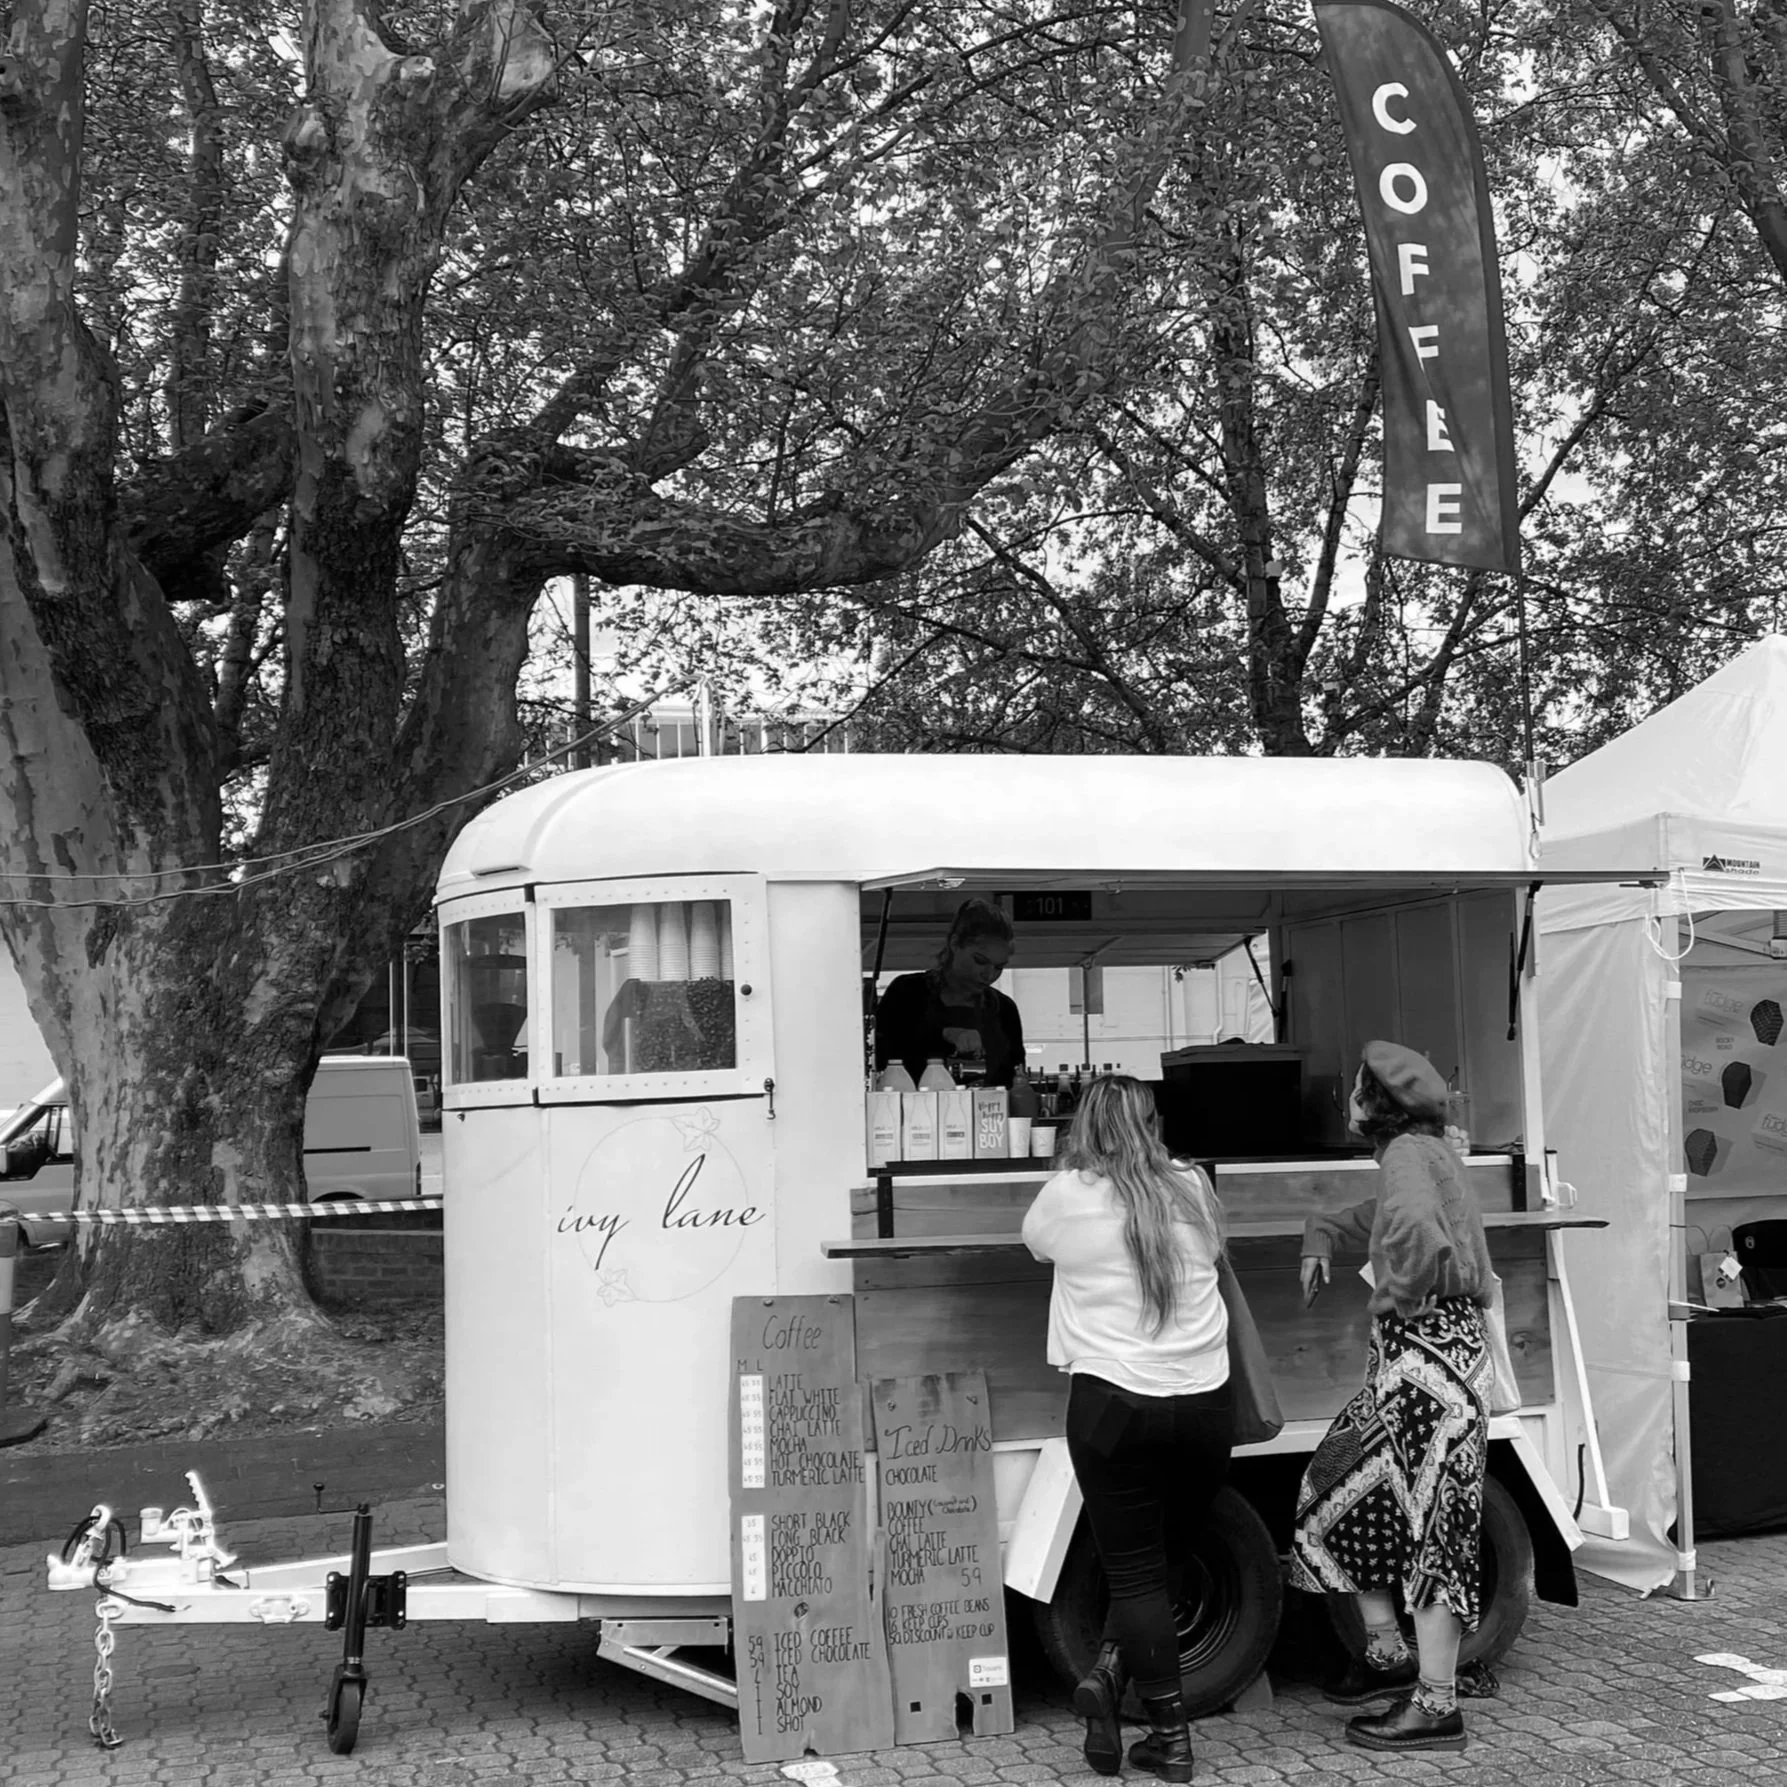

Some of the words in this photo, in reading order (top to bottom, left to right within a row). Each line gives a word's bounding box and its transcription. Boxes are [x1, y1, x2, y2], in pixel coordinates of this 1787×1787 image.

[1373, 82, 1463, 534] COFFEE
[1727, 859, 1760, 869] MOUNTAIN
[979, 1133, 1004, 1149] BOY
[557, 1205, 630, 1271] ivy
[661, 1153, 767, 1229] lane
[762, 1314, 822, 1350] Coffee
[737, 1359, 747, 1372] M
[757, 1359, 764, 1372] L
[768, 1373, 802, 1391] LATTE
[769, 1389, 795, 1406] FLAT
[803, 1387, 840, 1405] WHITE
[769, 1404, 837, 1421] CAPPUCCINO
[769, 1420, 798, 1438] CHAI
[808, 1419, 840, 1437] LATTE
[769, 1437, 807, 1455] MOCHA
[884, 1424, 934, 1460] Iced
[770, 1453, 791, 1470] HOT
[799, 1451, 860, 1469] CHOCOLATE
[771, 1469, 830, 1487] TURMERIC
[832, 1466, 865, 1485] LATTE
[885, 1465, 938, 1486] CHOCOLATE
[771, 1512, 807, 1531] SHORT
[816, 1511, 850, 1529] BLACK
[888, 1517, 925, 1536] COFFEE
[771, 1529, 800, 1547] LONG
[810, 1527, 846, 1546] BLACK
[889, 1535, 911, 1554] CHAI
[918, 1530, 947, 1551] LATTE
[771, 1545, 814, 1563] DOPPIO
[892, 1549, 944, 1569] TURMERIC
[948, 1545, 979, 1565] LATTE
[771, 1561, 823, 1581] PICCOLO
[891, 1568, 925, 1587] MOCHA
[771, 1577, 832, 1598] MACCHIATO
[901, 1603, 928, 1620] FRESH
[930, 1599, 960, 1616] COFFEE
[964, 1597, 990, 1614] BEANS
[902, 1616, 925, 1631] KEEP
[928, 1614, 949, 1630] CUPS
[774, 1631, 802, 1651] ICED
[810, 1626, 853, 1647] COFFEE
[903, 1628, 945, 1645] DISCOUNT
[956, 1624, 978, 1639] KEEP
[979, 1622, 995, 1637] CUP
[775, 1648, 802, 1666] ICED
[811, 1642, 871, 1663] CHOCOLATE
[776, 1664, 799, 1685] TEA
[776, 1681, 799, 1703] SOY
[776, 1696, 822, 1718] ALMOND
[777, 1715, 804, 1733] SHOT
